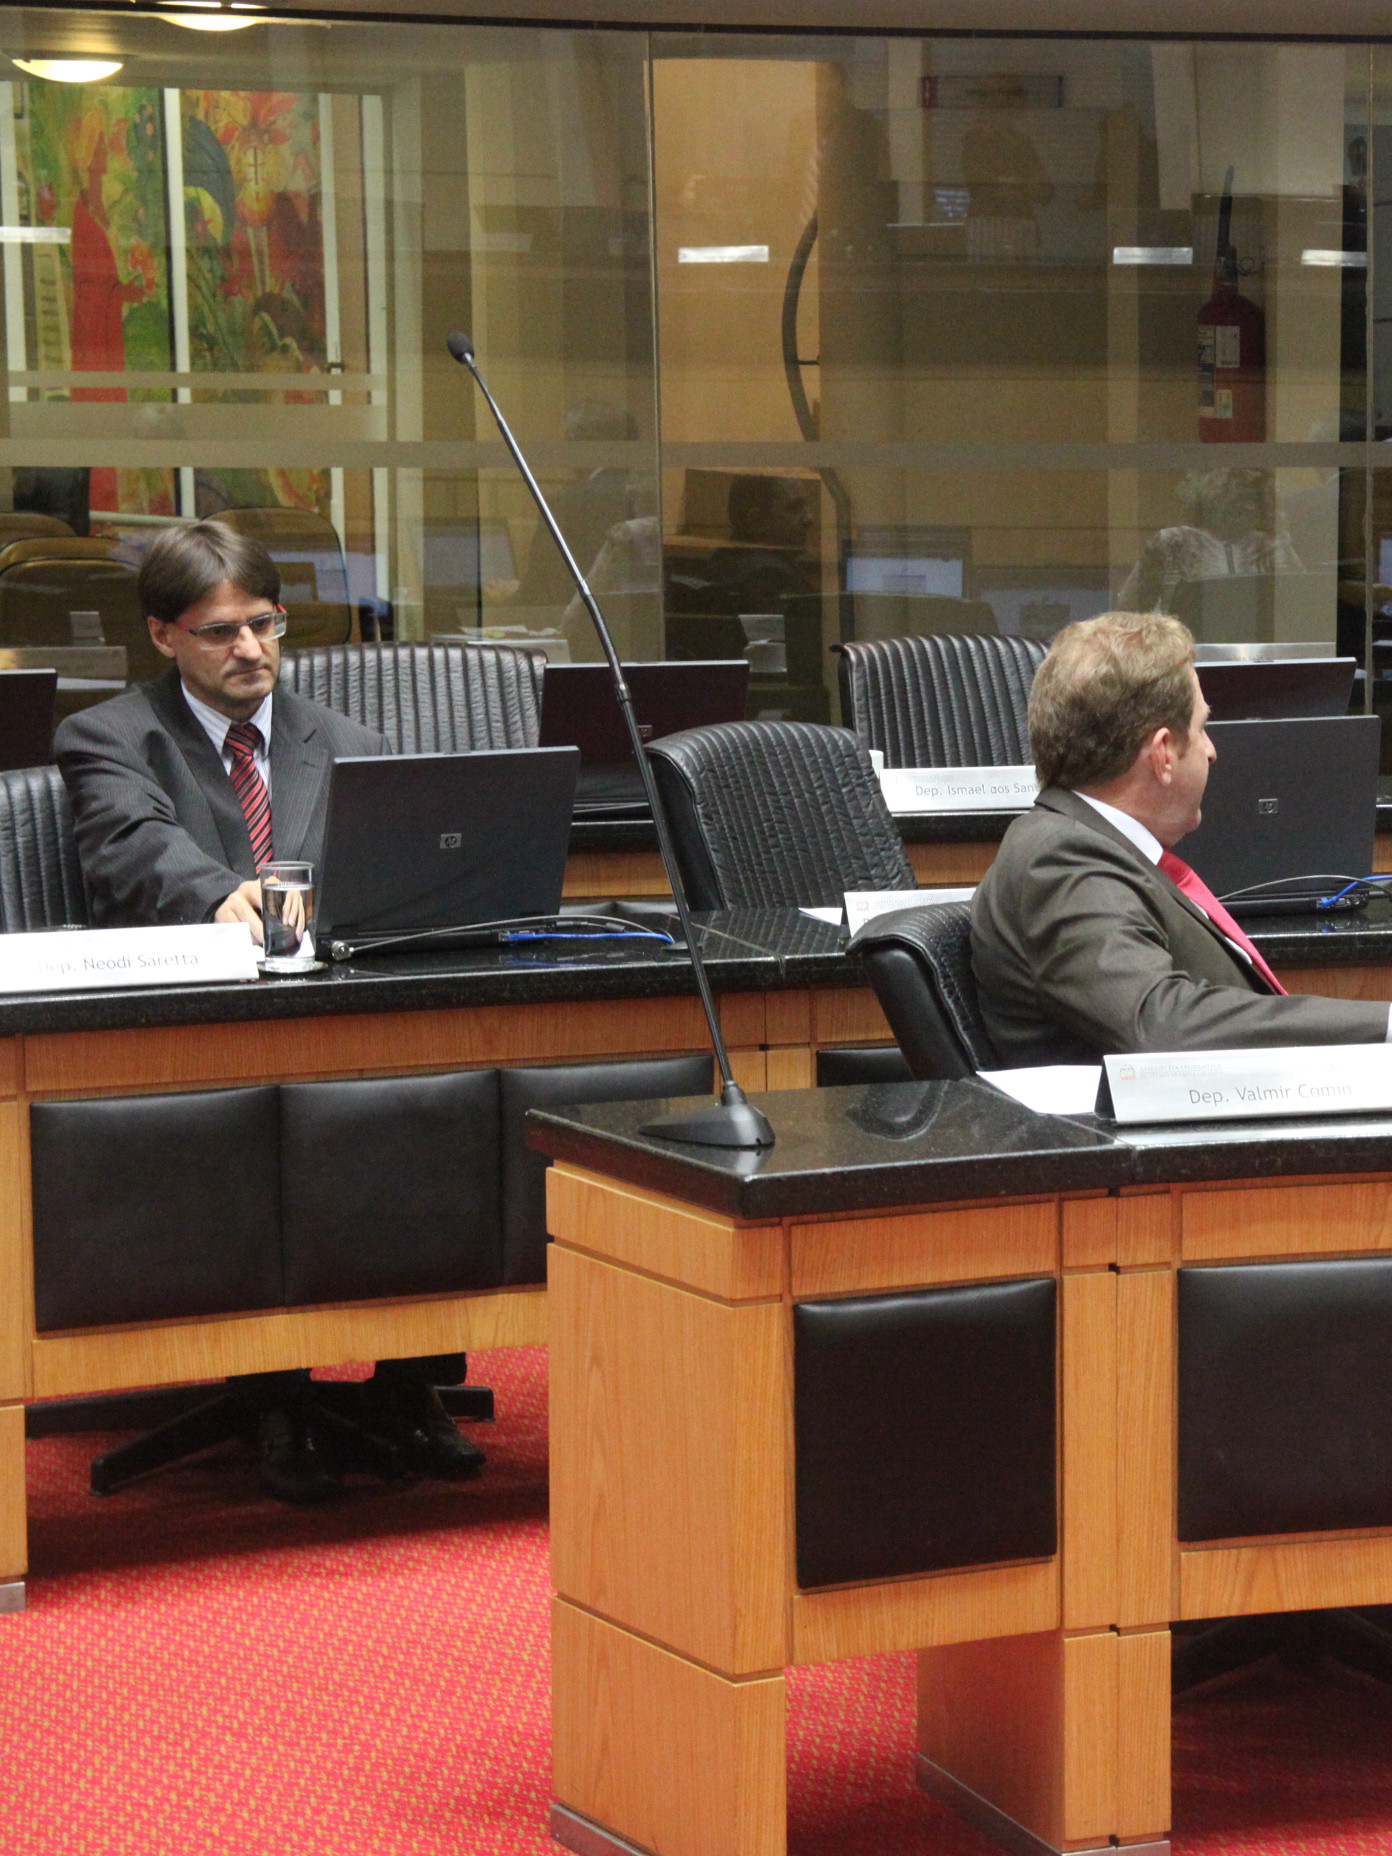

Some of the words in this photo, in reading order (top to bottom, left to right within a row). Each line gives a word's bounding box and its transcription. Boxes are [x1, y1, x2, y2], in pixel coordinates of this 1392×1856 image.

[915, 785, 943, 798] Dep.
[947, 784, 986, 796] Ismael
[83, 956, 131, 972] Neodi
[137, 953, 200, 968] Saretta
[1188, 1088, 1229, 1105] Dep.
[1235, 1085, 1291, 1102] Valmir
[1297, 1083, 1352, 1099] Comin
